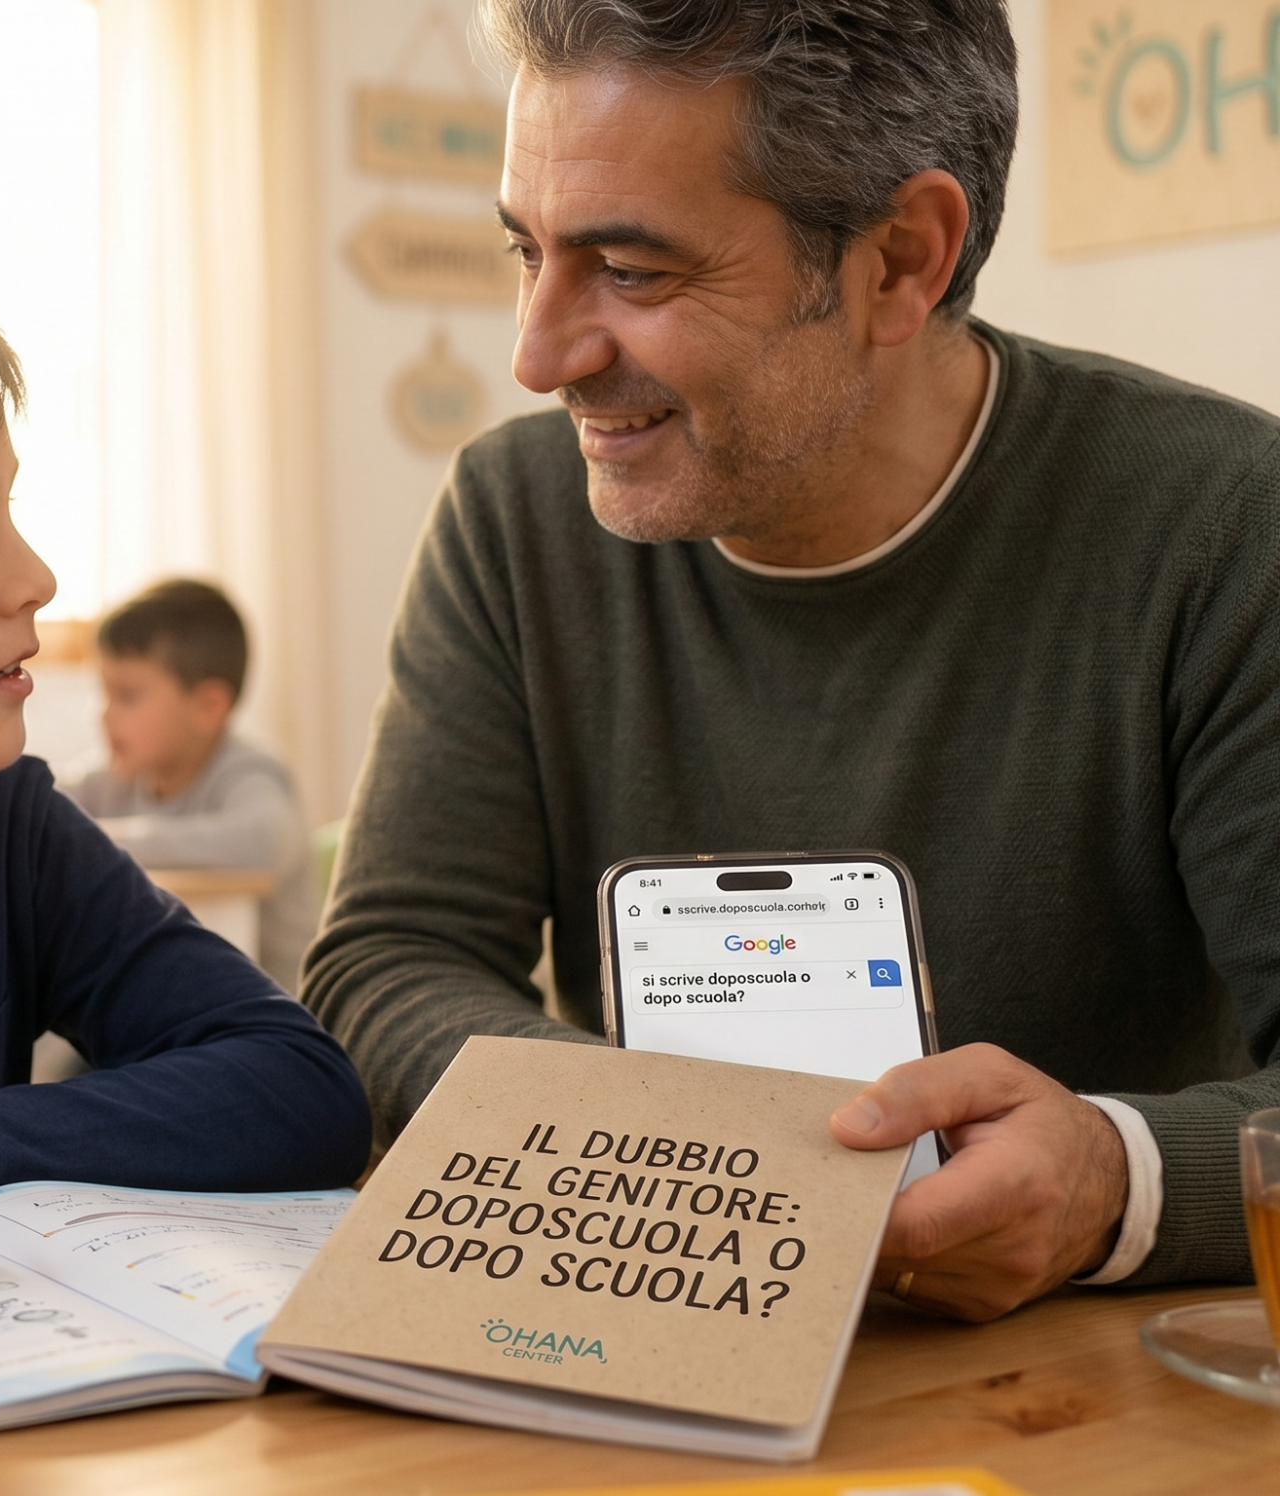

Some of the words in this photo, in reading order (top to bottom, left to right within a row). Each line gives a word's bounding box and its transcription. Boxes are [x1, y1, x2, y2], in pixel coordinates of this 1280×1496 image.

[639, 878, 662, 888] 8:41
[724, 934, 796, 955] Google
[643, 975, 654, 986] si
[660, 974, 703, 986] scrive
[708, 970, 797, 987] doposcuola
[801, 973, 810, 982] o
[644, 992, 681, 1007] dopo
[687, 990, 744, 1003] scuola?
[521, 1124, 559, 1155] IL
[580, 1131, 759, 1178] DUBBIO
[441, 1152, 522, 1190] DEL
[548, 1167, 800, 1225] GENITORE:
[405, 1189, 740, 1265] DOPOSCUOLA
[770, 1238, 805, 1271] O
[378, 1230, 523, 1279] DOPO
[541, 1252, 790, 1318] SCUOLA?
[502, 1347, 564, 1365] CENTER
